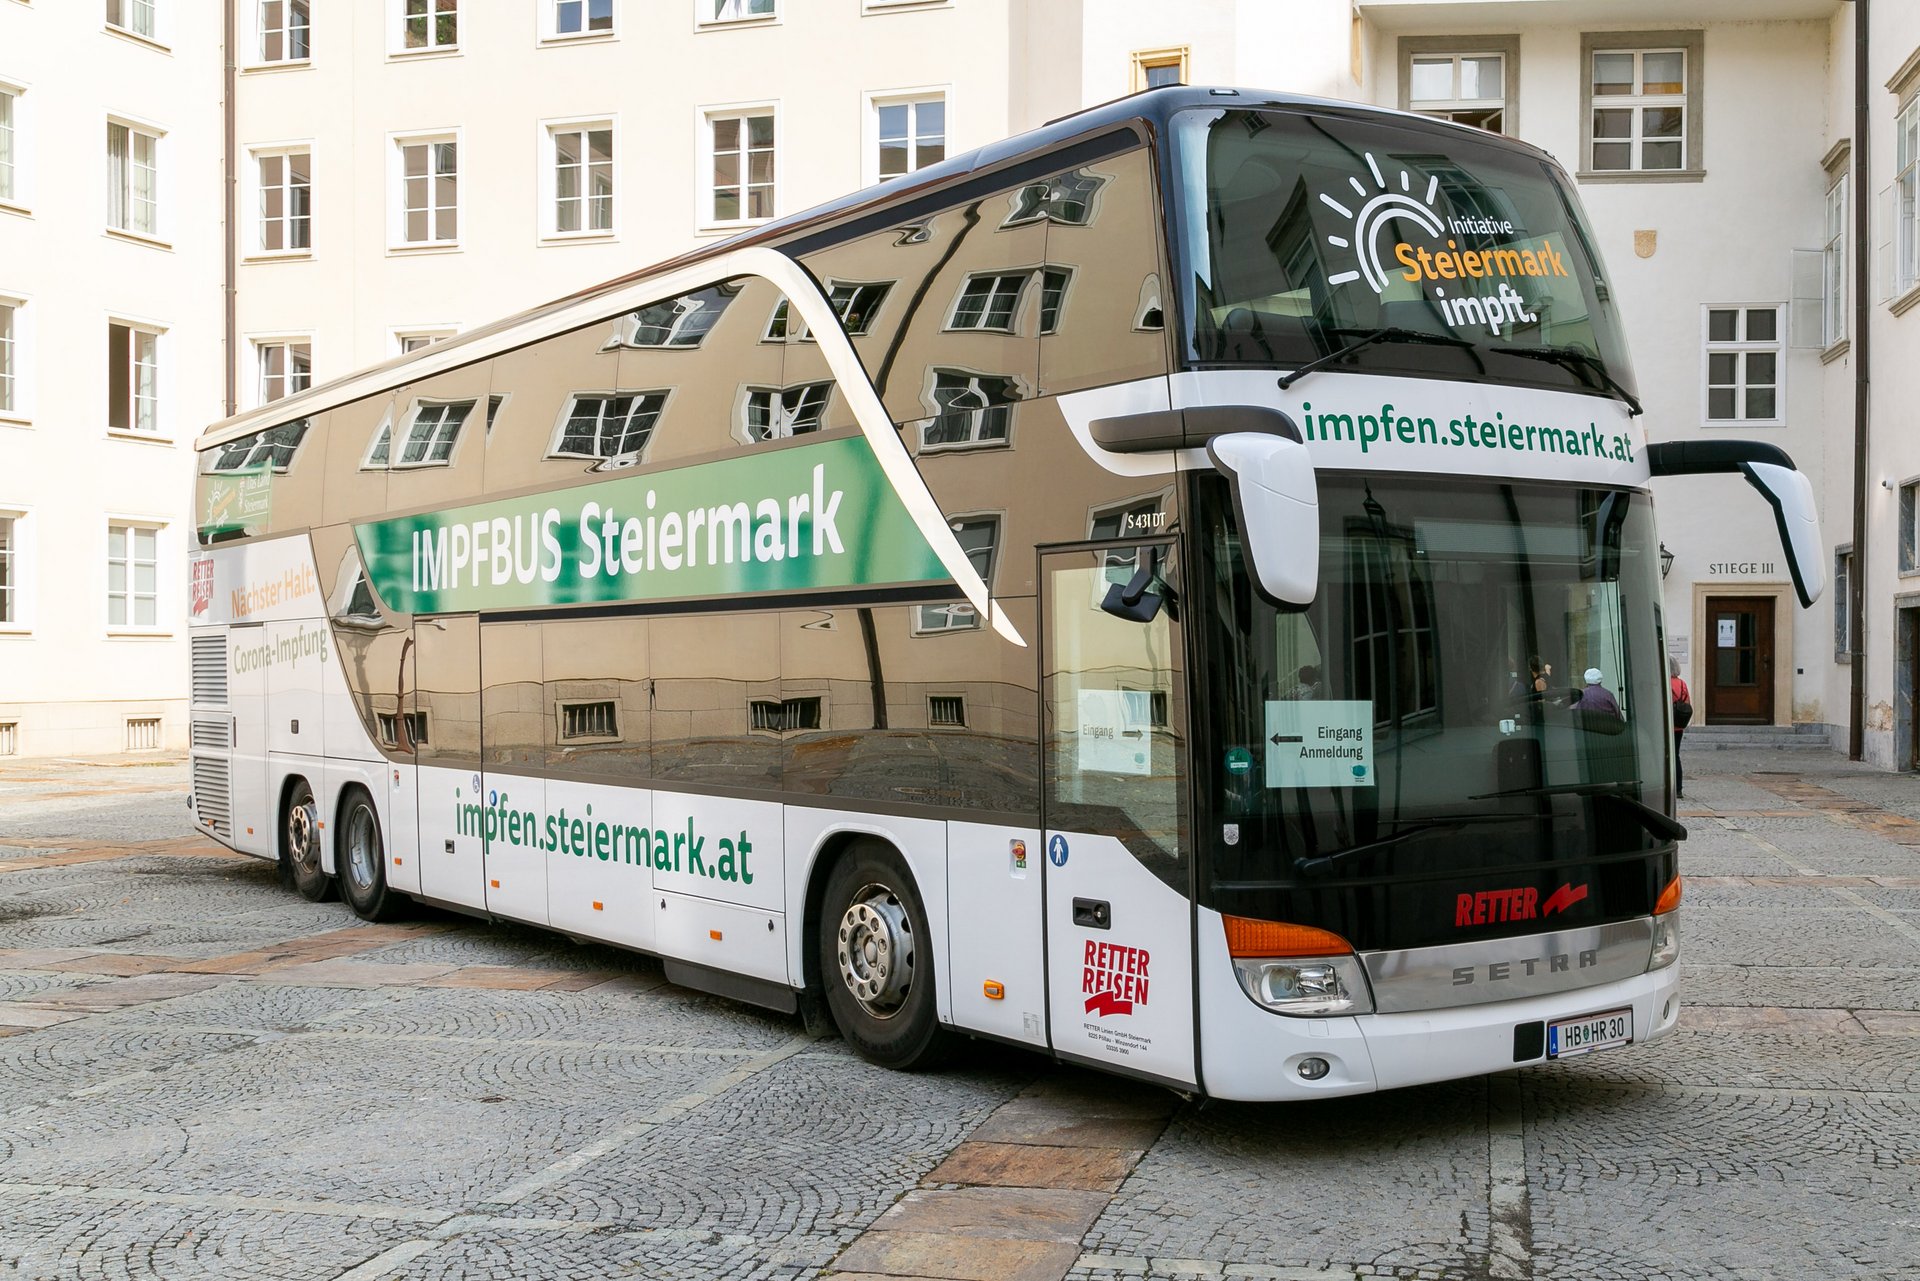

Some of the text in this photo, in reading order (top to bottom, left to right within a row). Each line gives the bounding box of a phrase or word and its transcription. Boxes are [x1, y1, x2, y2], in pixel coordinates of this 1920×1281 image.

[1447, 216, 1513, 235] Initiative
[1394, 239, 1569, 282] Steiermark
[1435, 282, 1538, 336] impft.
[1302, 401, 1635, 463] impfen.steiermark.at
[412, 463, 845, 592] IMPFBUS Steiermark
[1127, 512, 1166, 529] S 431 DT
[193, 559, 214, 581] RETTER
[1709, 562, 1774, 575] STIEGE III
[192, 580, 214, 601] REISEN
[231, 562, 316, 619] Nächster Halt:
[233, 625, 328, 674] Corona-Impfung
[1082, 724, 1114, 740] Eingang
[1317, 726, 1363, 741] Eingang
[1299, 746, 1364, 761] Anmeldung
[455, 787, 754, 885] impfen.steiermark.at
[1455, 887, 1539, 927] RETTER
[1084, 939, 1150, 977] RETTER
[1452, 949, 1598, 986] SETRA
[1082, 968, 1150, 1006] REISEN
[1083, 1023, 1100, 1032] RETTER
[1565, 1025, 1582, 1047] HB
[1591, 1020, 1607, 1042] HR
[1609, 1017, 1624, 1039] 30
